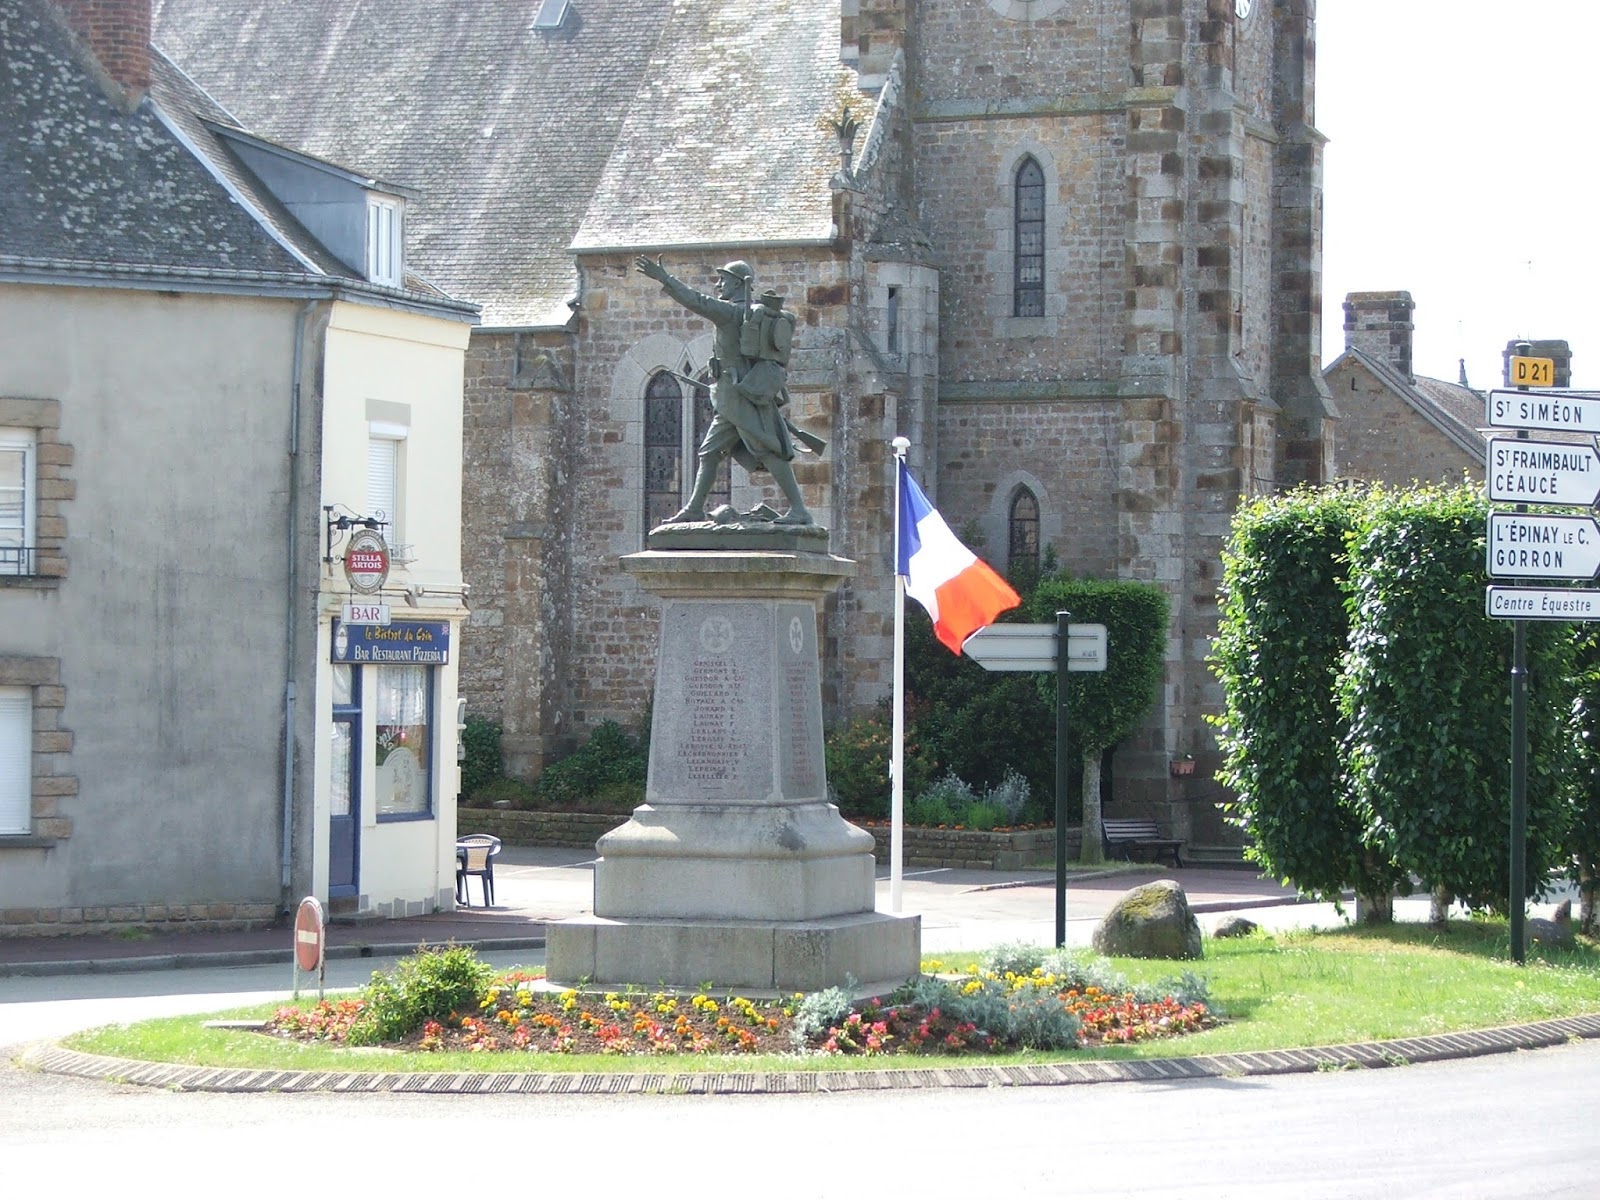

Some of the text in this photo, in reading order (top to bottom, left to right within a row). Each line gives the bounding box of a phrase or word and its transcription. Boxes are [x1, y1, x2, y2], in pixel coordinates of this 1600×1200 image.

[1518, 362, 1548, 382] D 21
[1520, 400, 1582, 424] SIMÉON
[1513, 450, 1592, 472] FRAIMBAULT
[1496, 470, 1558, 495] CÉAUCÉ
[1497, 520, 1590, 545] L'ÉPINAY LE C.
[351, 554, 382, 562] STELLA
[351, 561, 382, 569] ARTOIS
[1496, 549, 1563, 568] GORRON
[351, 607, 380, 621] BAR
[1495, 593, 1592, 615] Centre Équestre
[354, 644, 441, 661] BAR RESTAURANT PIZZERIA
